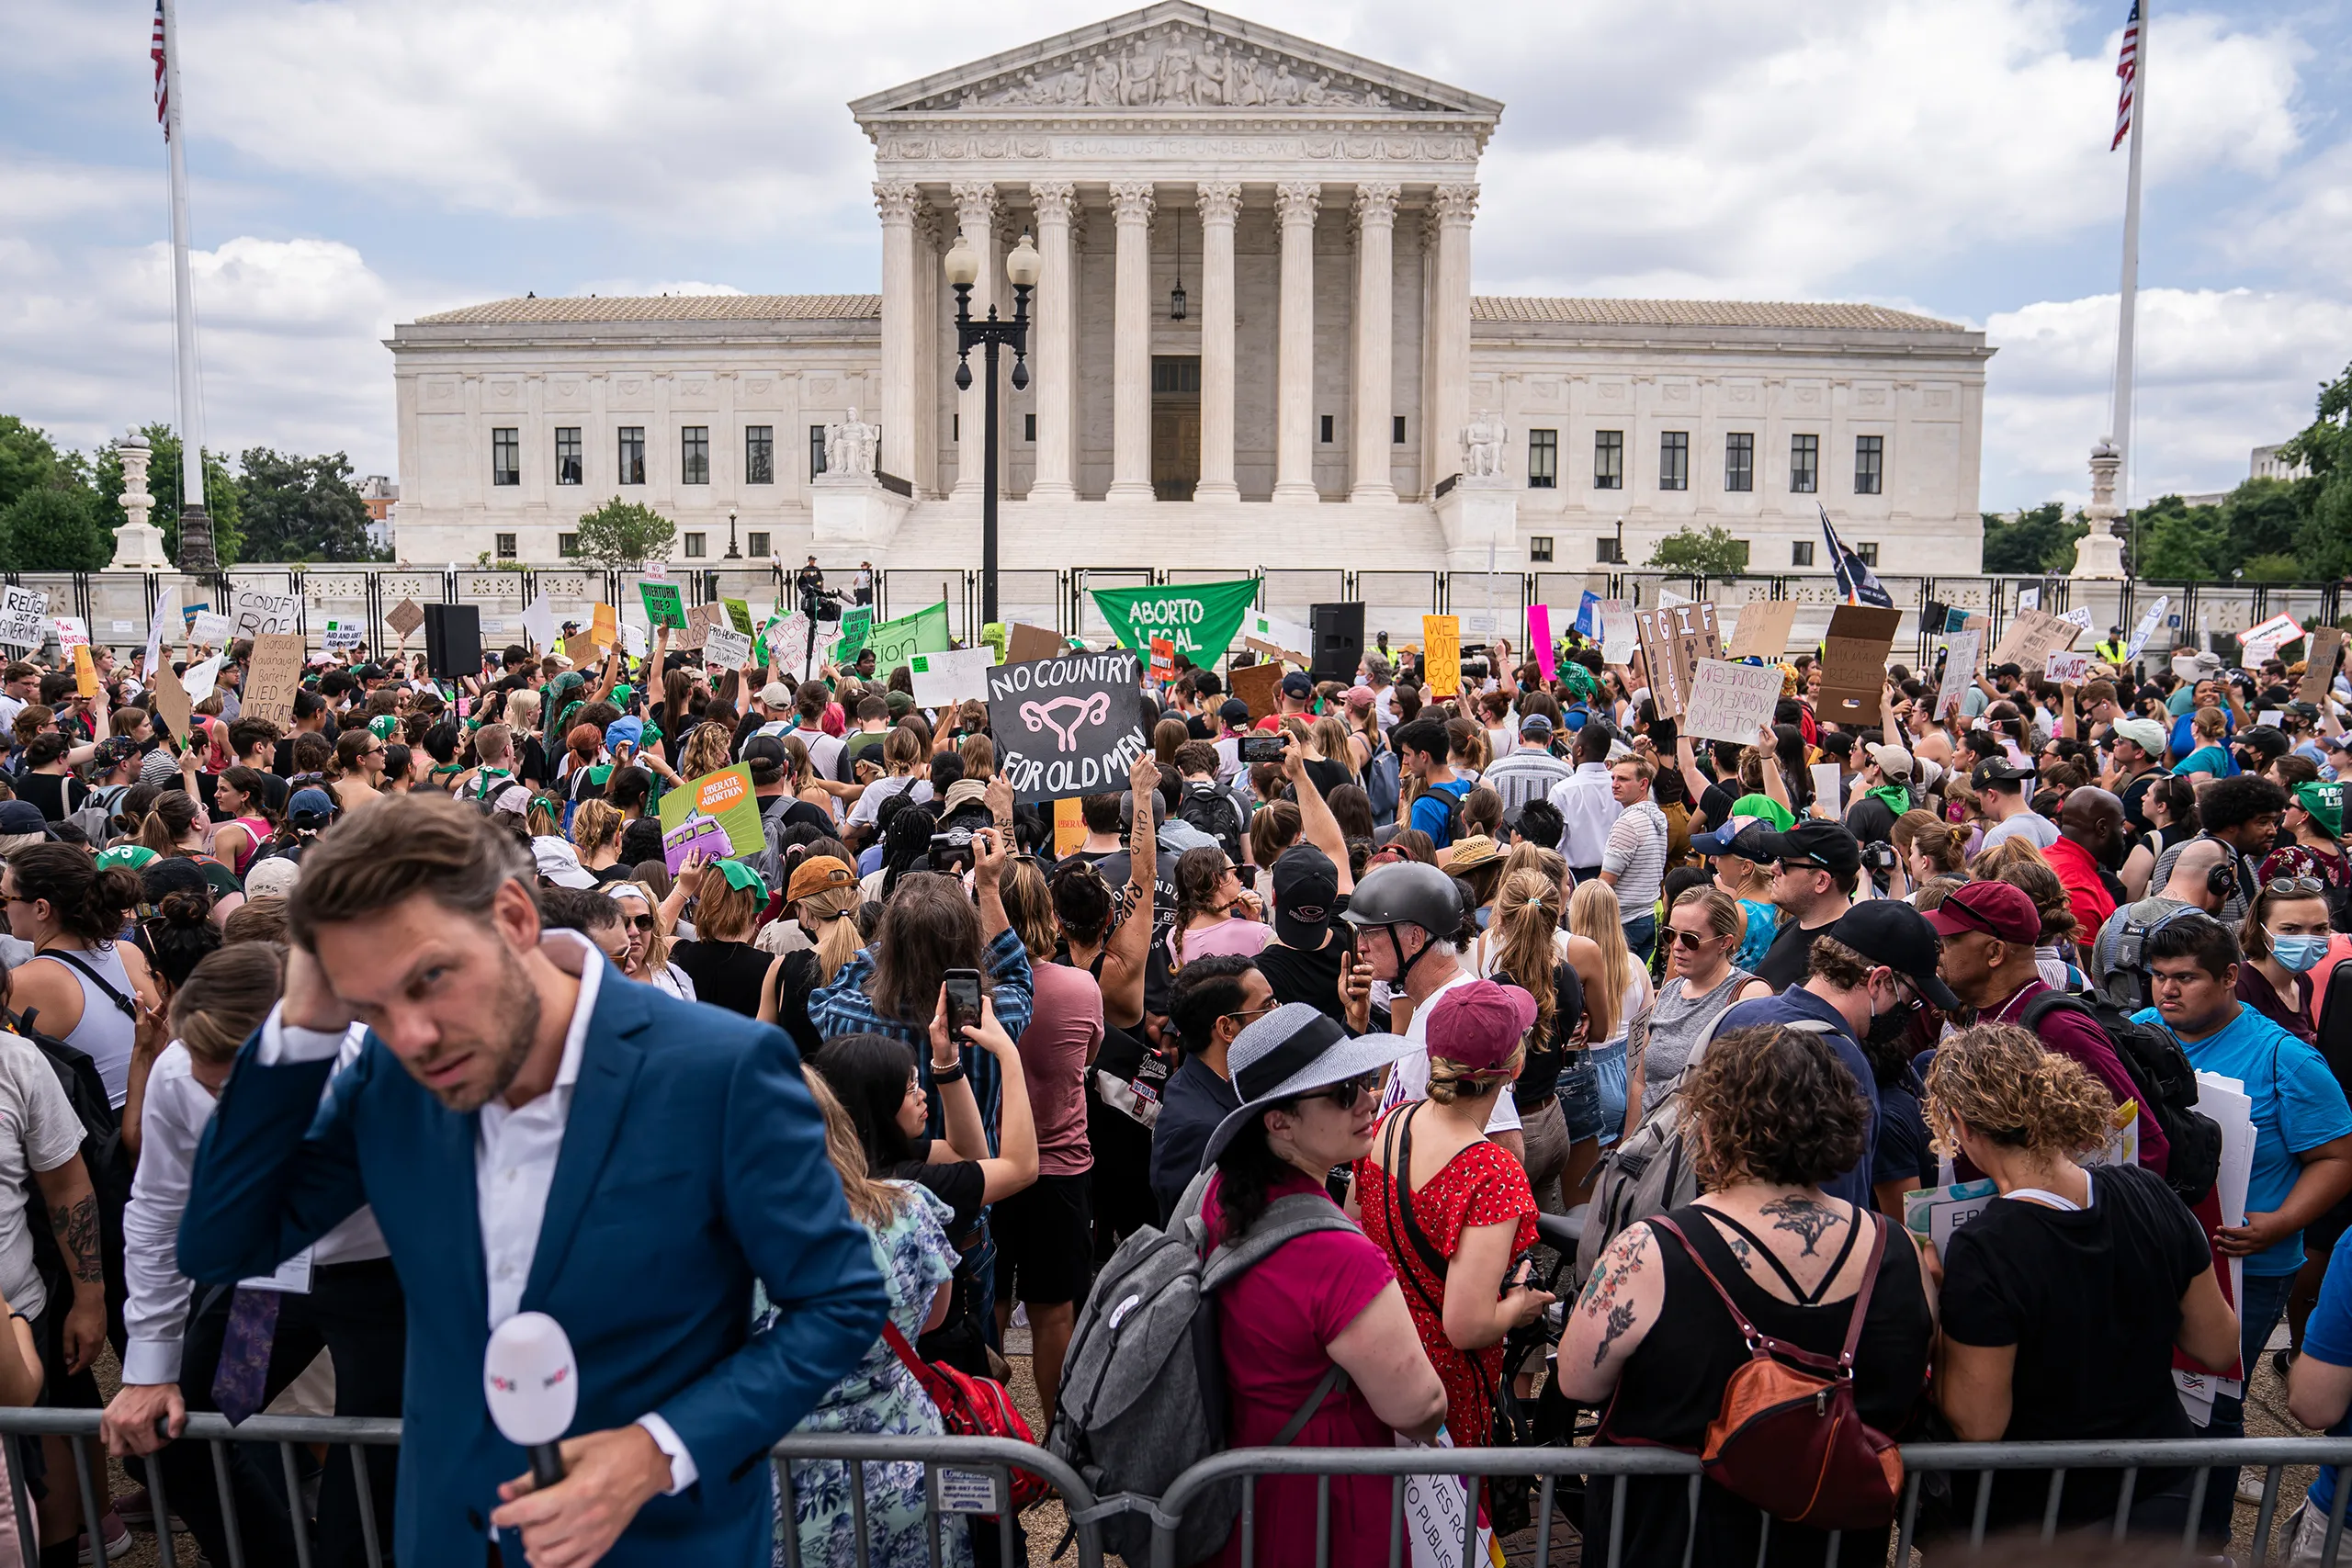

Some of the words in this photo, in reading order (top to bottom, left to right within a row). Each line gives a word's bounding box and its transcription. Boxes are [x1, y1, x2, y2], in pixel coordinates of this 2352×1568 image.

[1062, 141, 1117, 154] EQUAL
[1123, 141, 1188, 154] JUSTICE
[1196, 141, 1250, 154] UNDER
[1257, 141, 1288, 154] LAW
[643, 585, 677, 599] OVERTURN
[238, 592, 300, 617] CODIFY
[1128, 599, 1204, 626] ABORTO
[15, 613, 30, 622] OUT
[236, 612, 290, 637] ROE
[844, 610, 870, 623] OVERTURN
[1425, 616, 1453, 636] WE
[59, 635, 90, 644] ABORTION
[263, 636, 295, 651] Gorsuch
[1424, 637, 1460, 660] WONT
[253, 654, 299, 670] Kavanaugh
[1427, 660, 1454, 678] GO
[258, 669, 288, 682] Barrett
[990, 666, 1031, 701] NO
[1034, 653, 1136, 688] COUNTRY
[247, 685, 278, 700] LIED
[242, 702, 271, 719] UNDER
[1003, 750, 1045, 793] FOR
[1046, 757, 1100, 793] OLD
[1102, 725, 1148, 784] MEN
[703, 775, 740, 796] LIBERATE
[701, 784, 743, 807] ABORTION
[1132, 809, 1148, 855] CHILD
[1416, 1504, 1455, 1568] PUBLIS
